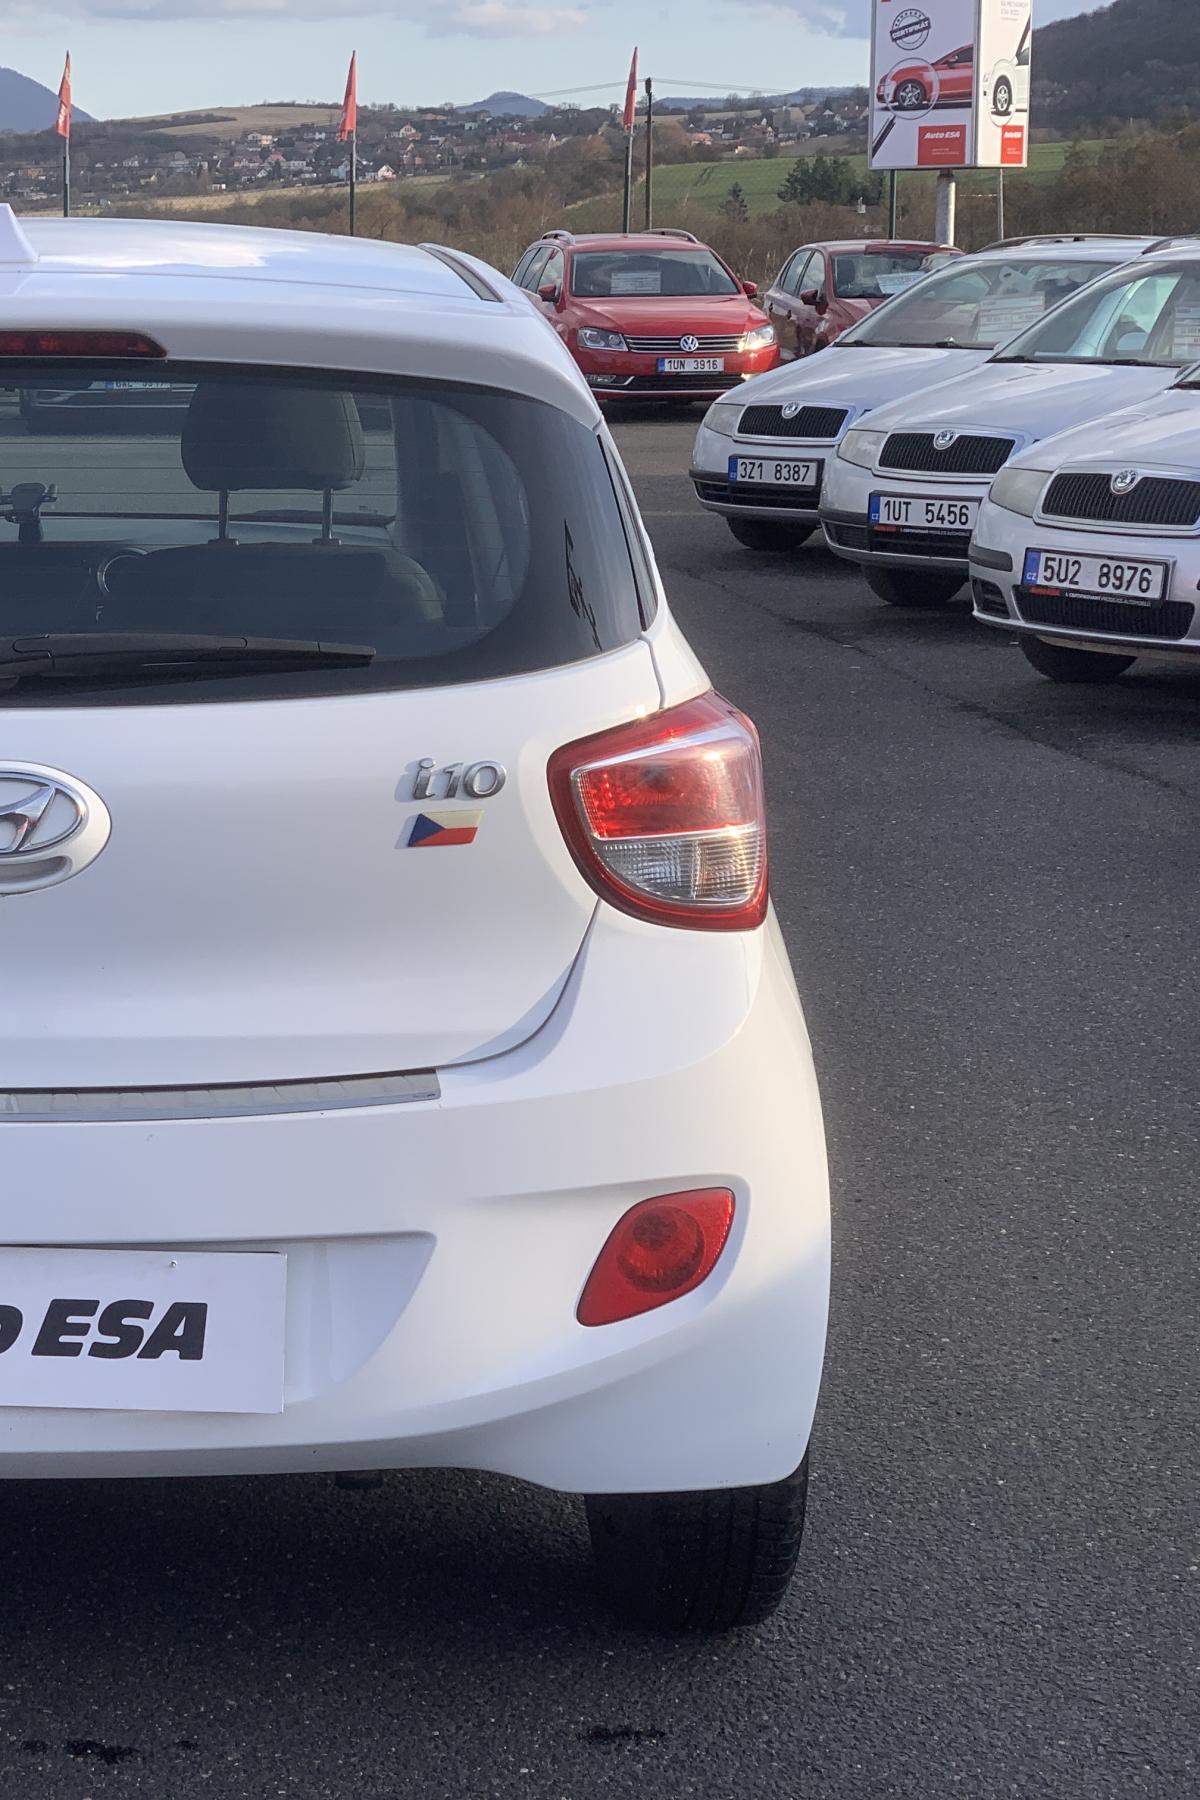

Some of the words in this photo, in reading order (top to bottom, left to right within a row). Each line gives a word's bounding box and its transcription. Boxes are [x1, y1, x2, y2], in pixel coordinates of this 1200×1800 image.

[924, 131, 944, 139] Auto
[668, 360, 686, 370] 1UN
[694, 360, 718, 370] 3916
[740, 462, 763, 480] 3Z1
[774, 463, 810, 482] 8387
[884, 499, 911, 522] 1UT
[925, 502, 970, 526] 5456
[1026, 572, 1036, 580] CZ
[1043, 556, 1081, 586] 5U2
[1098, 563, 1152, 593] 8976
[31, 1298, 208, 1360] ESA
